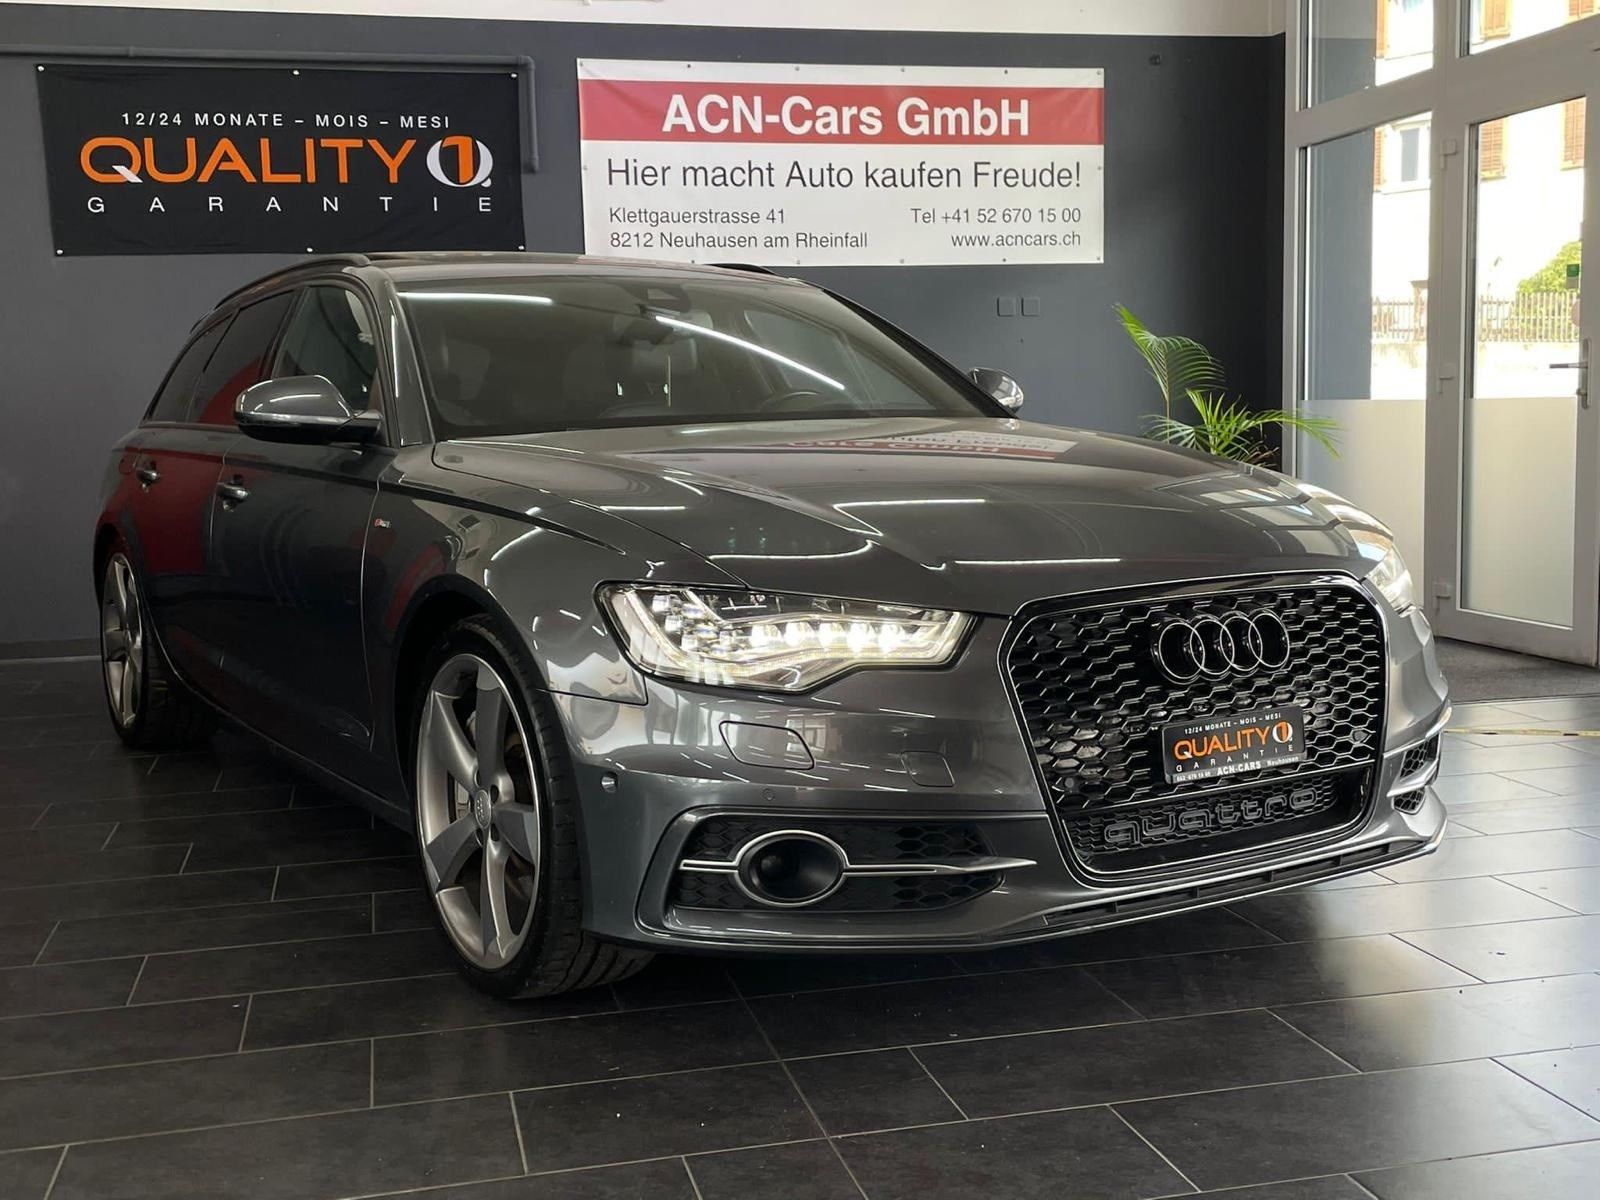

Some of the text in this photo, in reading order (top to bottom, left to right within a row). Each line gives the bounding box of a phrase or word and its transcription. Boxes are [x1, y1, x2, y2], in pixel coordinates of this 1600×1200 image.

[121, 112, 182, 126] 12/24
[194, 112, 283, 127] MONATE
[315, 114, 368, 128] MOIS
[400, 115, 449, 129] MESI
[661, 93, 1029, 136] ACN-Cars GmbH
[80, 136, 417, 184] QUALITY
[607, 158, 1081, 189] Hier macht Auto kaufen Freude!
[87, 196, 492, 213] GARANTIE
[609, 207, 785, 228] Klettgauerstrasse 41
[910, 207, 1081, 224] Tel +41 52 670 15 00
[610, 231, 868, 248] 8212 Neuhausen am Rheinfall
[951, 231, 1081, 247] www.acncars.ch
[1204, 721, 1232, 731] MONATE
[1240, 716, 1257, 725] MOIS
[1265, 712, 1281, 721] MESI
[1173, 725, 1270, 760] QUALITY
[1175, 744, 1293, 773] GARANTIE
[1216, 761, 1262, 776] ACN-CARS
[1104, 787, 1317, 844] quattro
